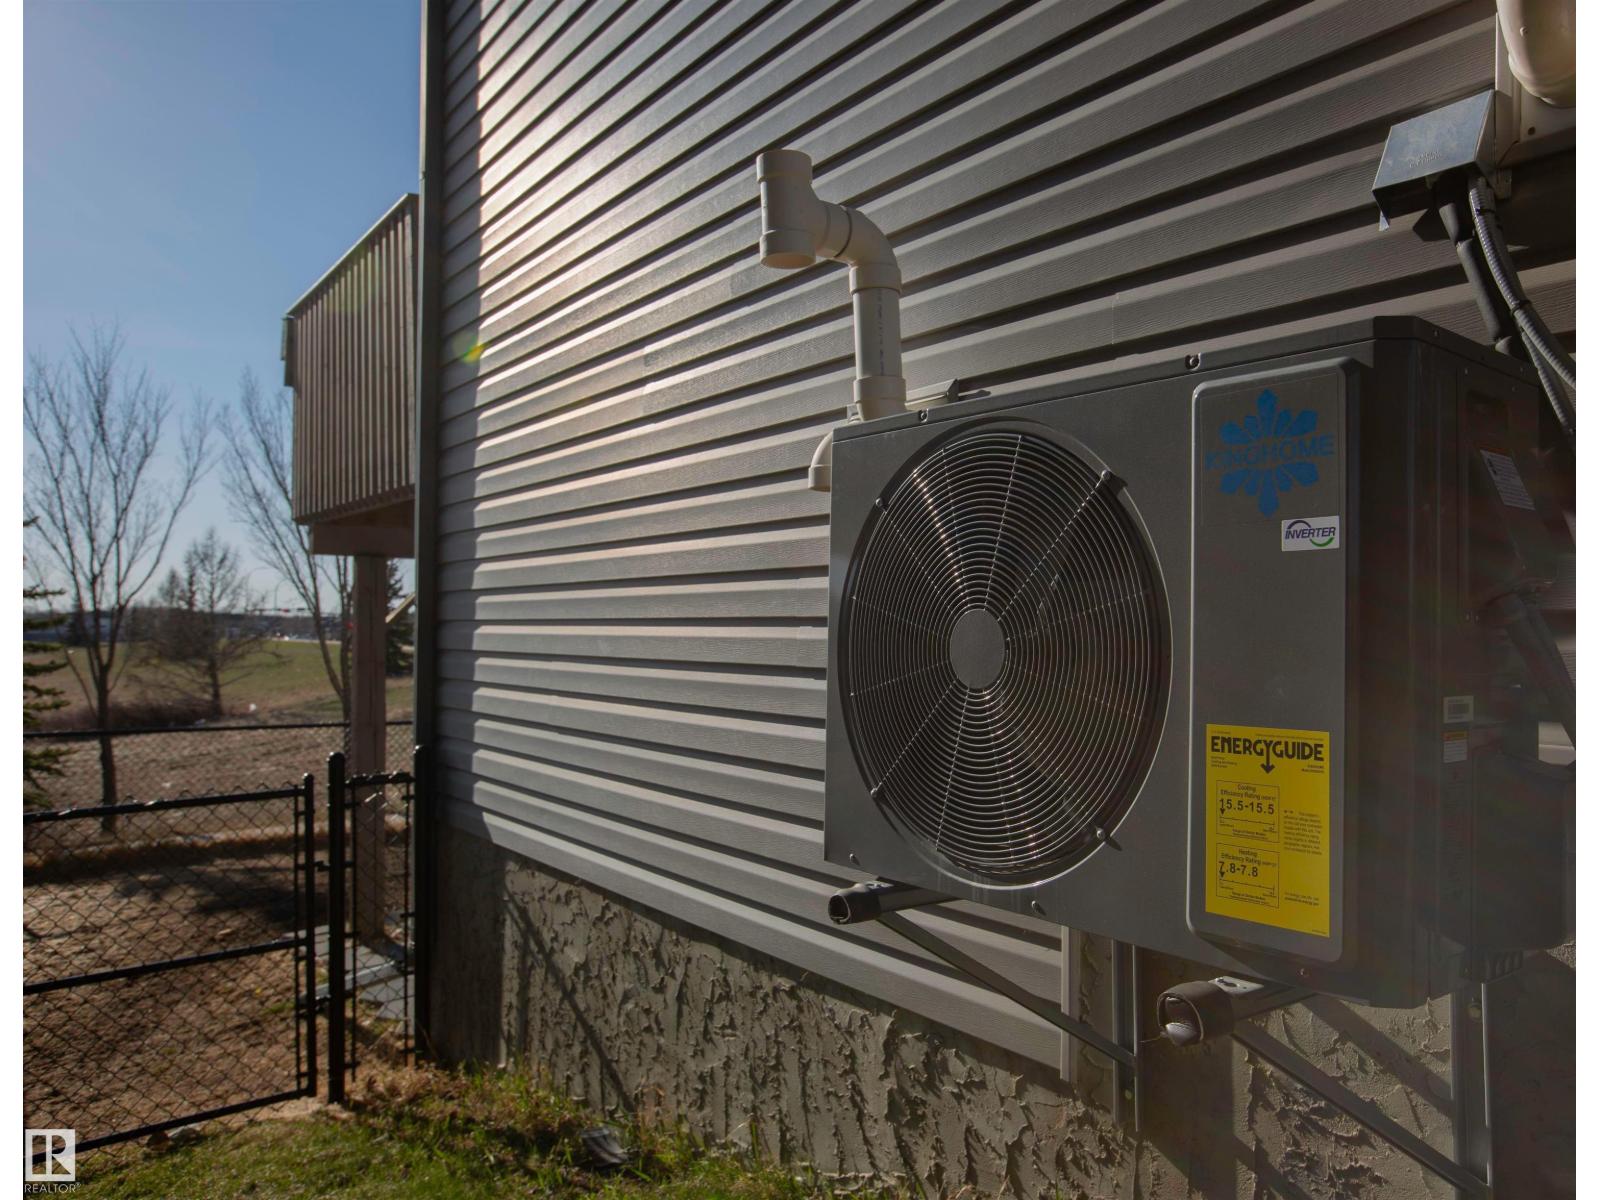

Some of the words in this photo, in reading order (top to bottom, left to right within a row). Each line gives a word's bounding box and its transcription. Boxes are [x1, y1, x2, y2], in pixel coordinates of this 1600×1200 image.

[1205, 433, 1335, 469] KINGHOME
[1284, 526, 1337, 541] INVERTER
[1210, 735, 1324, 762] ENERGYGUIDE
[1220, 789, 1244, 798] Efficiency
[1244, 792, 1261, 800] Rating
[1237, 783, 1257, 793] Cooling
[1219, 798, 1275, 815] 15.5-15.5
[1221, 852, 1245, 862] Efficiency
[1245, 856, 1261, 866] Rating
[1238, 848, 1258, 858] Heating
[1218, 860, 1258, 878] 7.8-7.8
